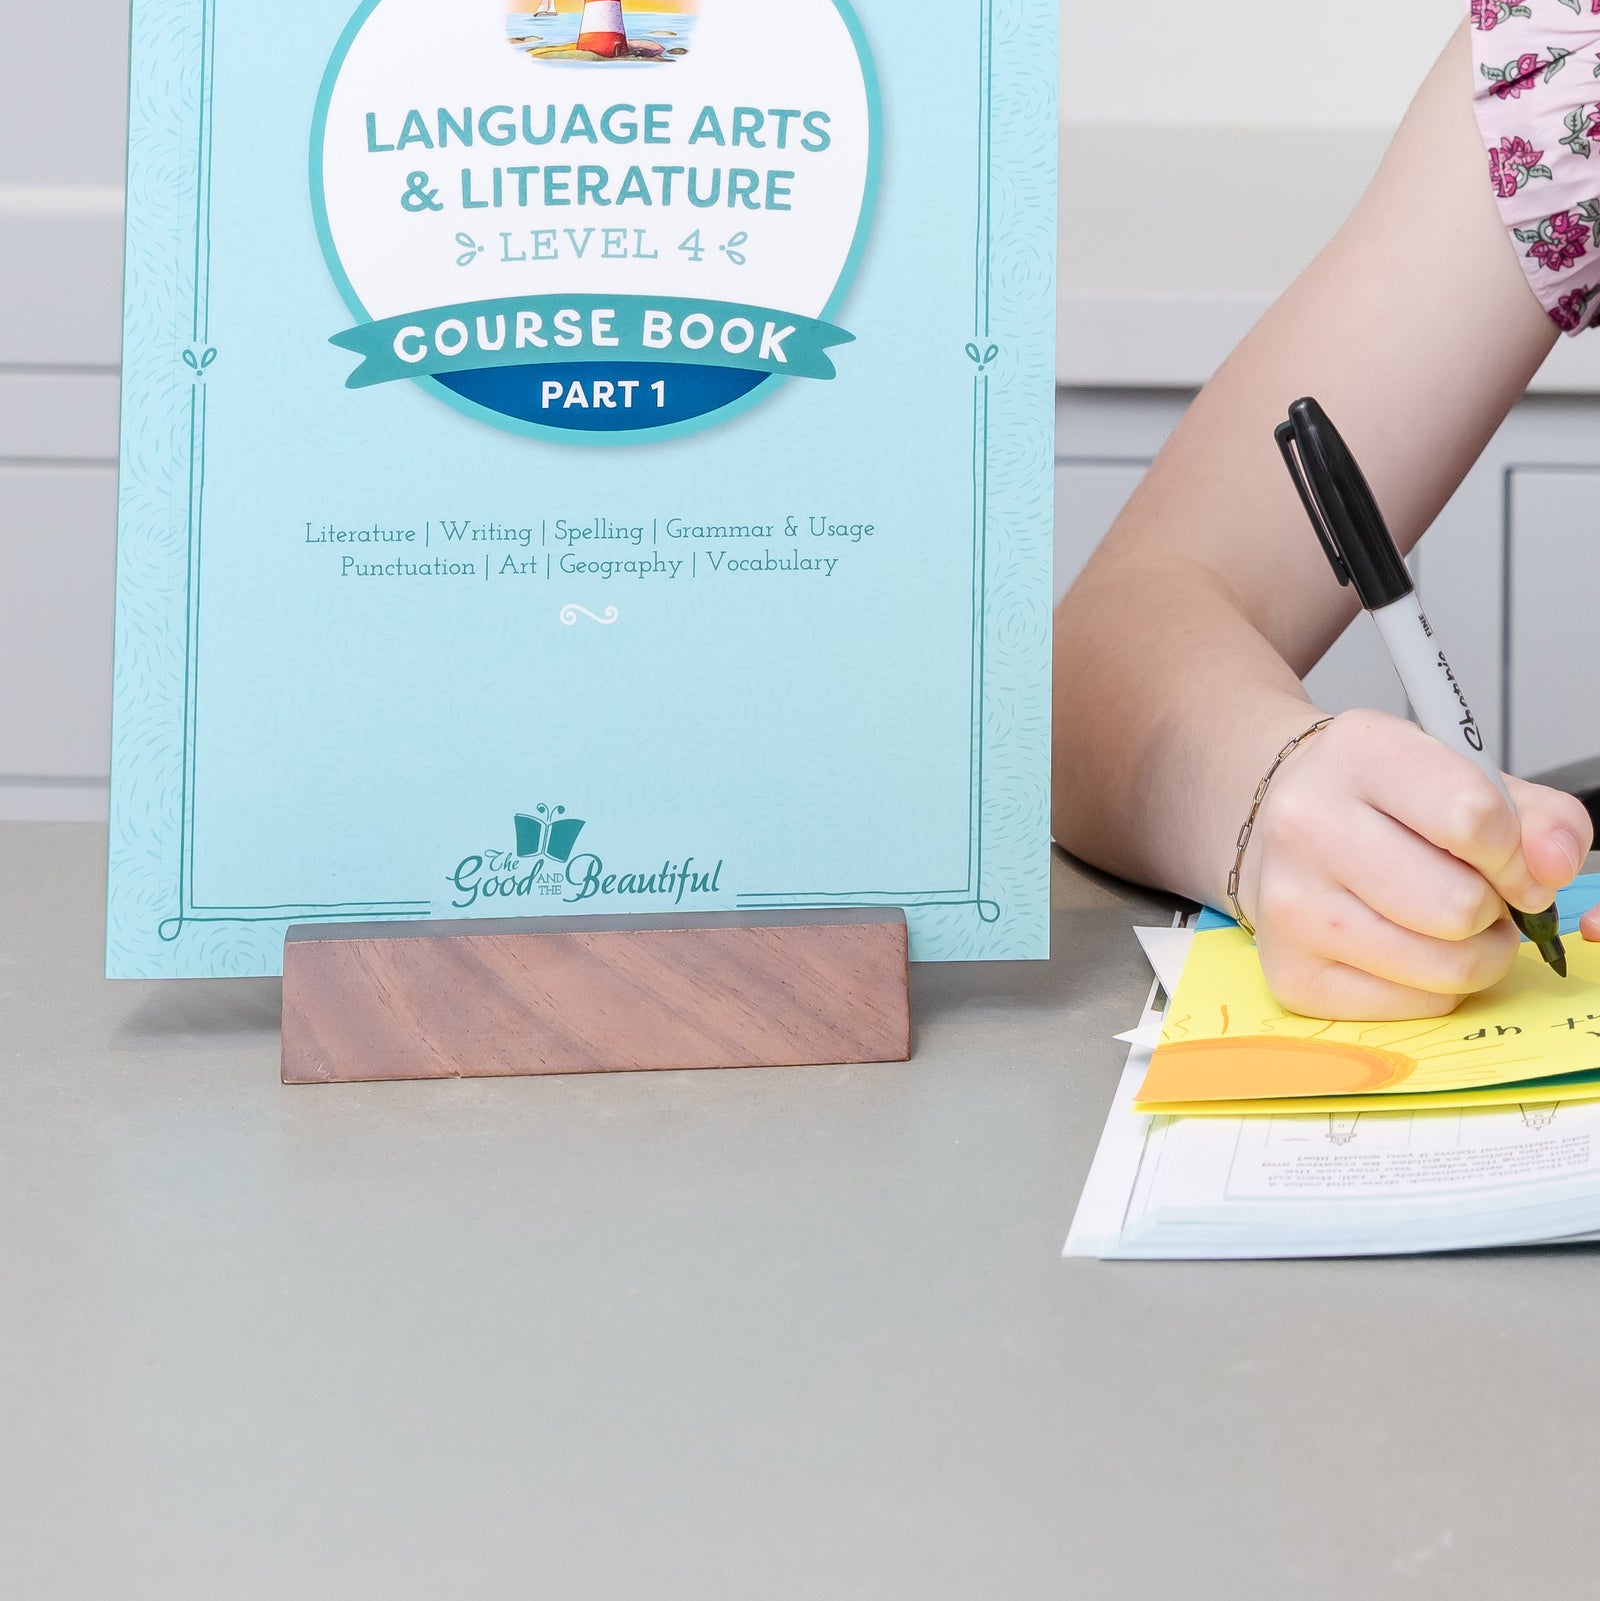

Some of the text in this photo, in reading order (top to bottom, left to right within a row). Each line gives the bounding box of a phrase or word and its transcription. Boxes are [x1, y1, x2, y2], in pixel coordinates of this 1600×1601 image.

[366, 103, 831, 152] LANGUAGE ARTS
[400, 165, 795, 212] & LITERATURE
[500, 228, 706, 263] LEVEL 4
[393, 308, 798, 363] COURSE BOOK
[541, 380, 667, 409] PART 1
[304, 515, 875, 547] Literature Writing Spelling Grammar & Usage
[341, 548, 840, 580] Punctuation Art Geography Vocabulary
[1417, 613, 1435, 639] FINE
[484, 849, 520, 872] The
[446, 853, 723, 908] Good AND THE Beautiful
[1461, 1024, 1521, 1041] up
